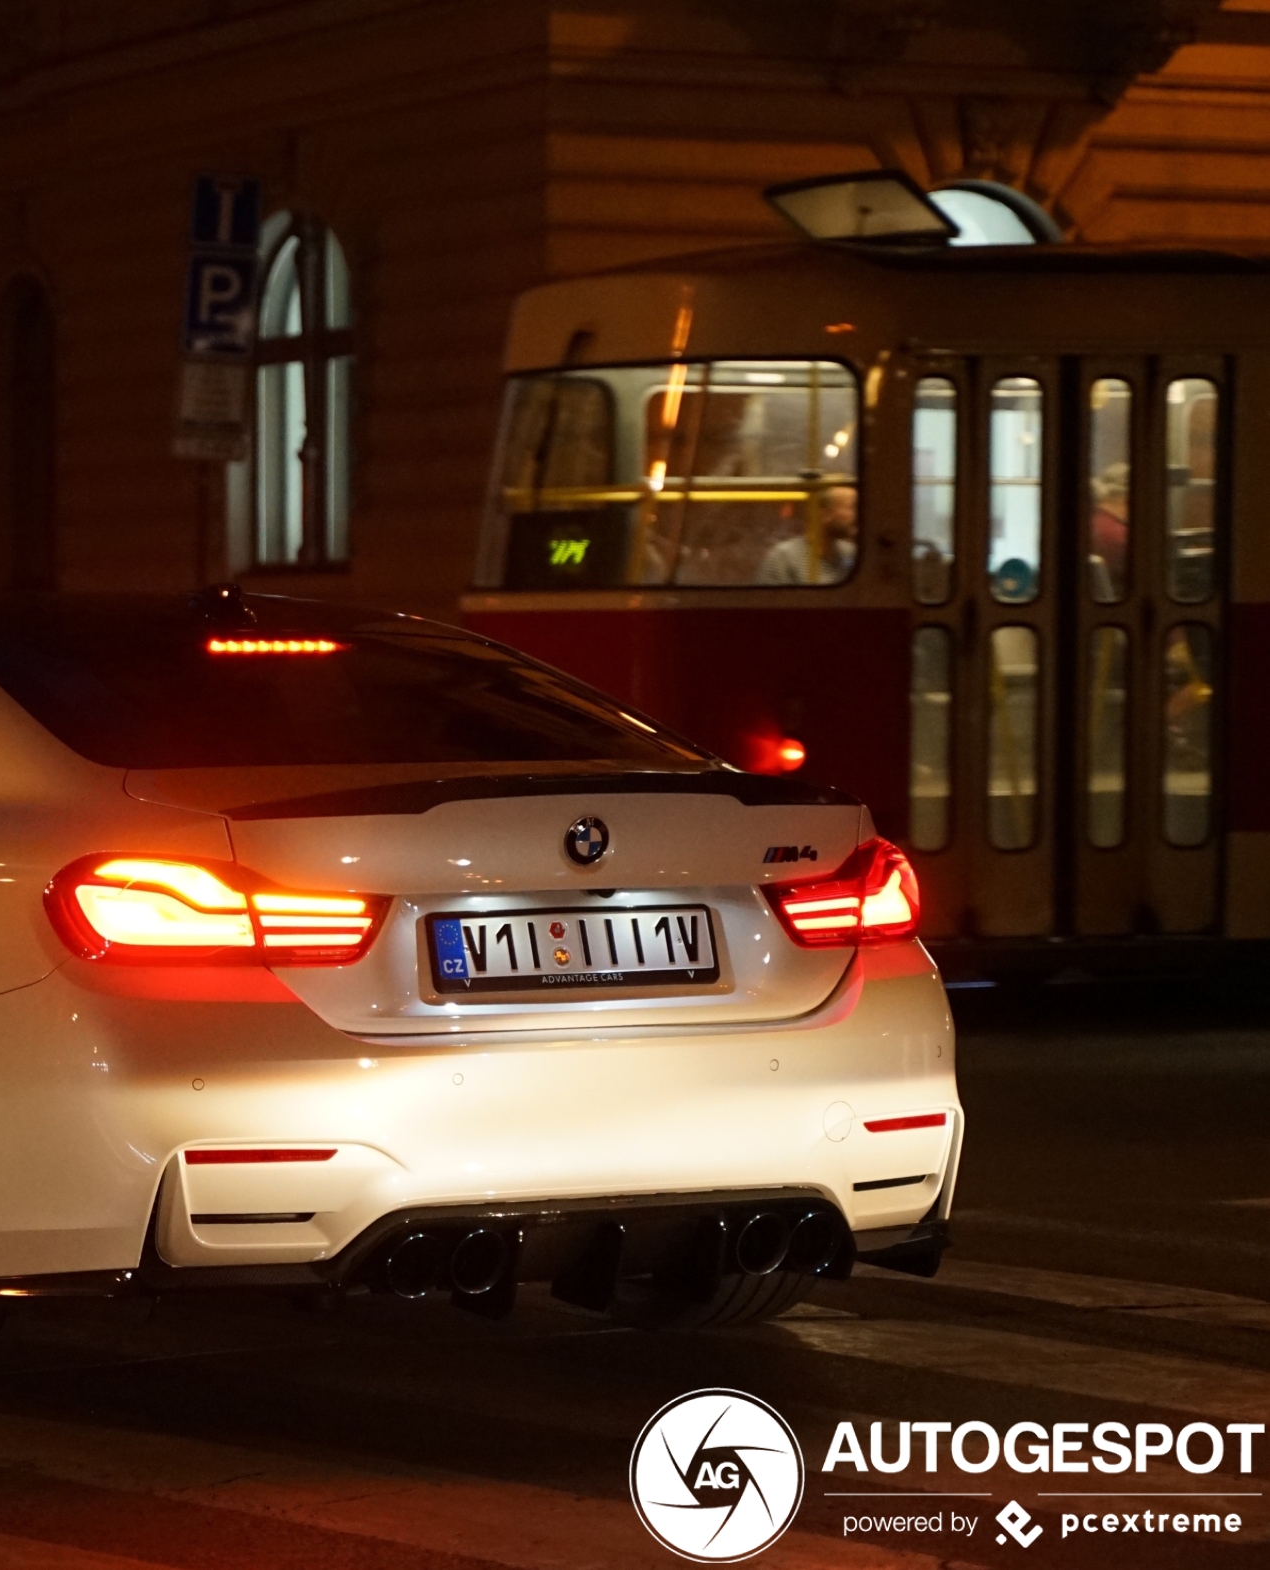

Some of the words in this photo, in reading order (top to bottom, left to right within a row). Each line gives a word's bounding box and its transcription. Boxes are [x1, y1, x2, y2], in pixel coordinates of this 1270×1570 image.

[198, 264, 242, 323] P
[443, 958, 465, 974] CZ
[541, 974, 599, 984] ADVANTAGE
[601, 972, 624, 982] CARS
